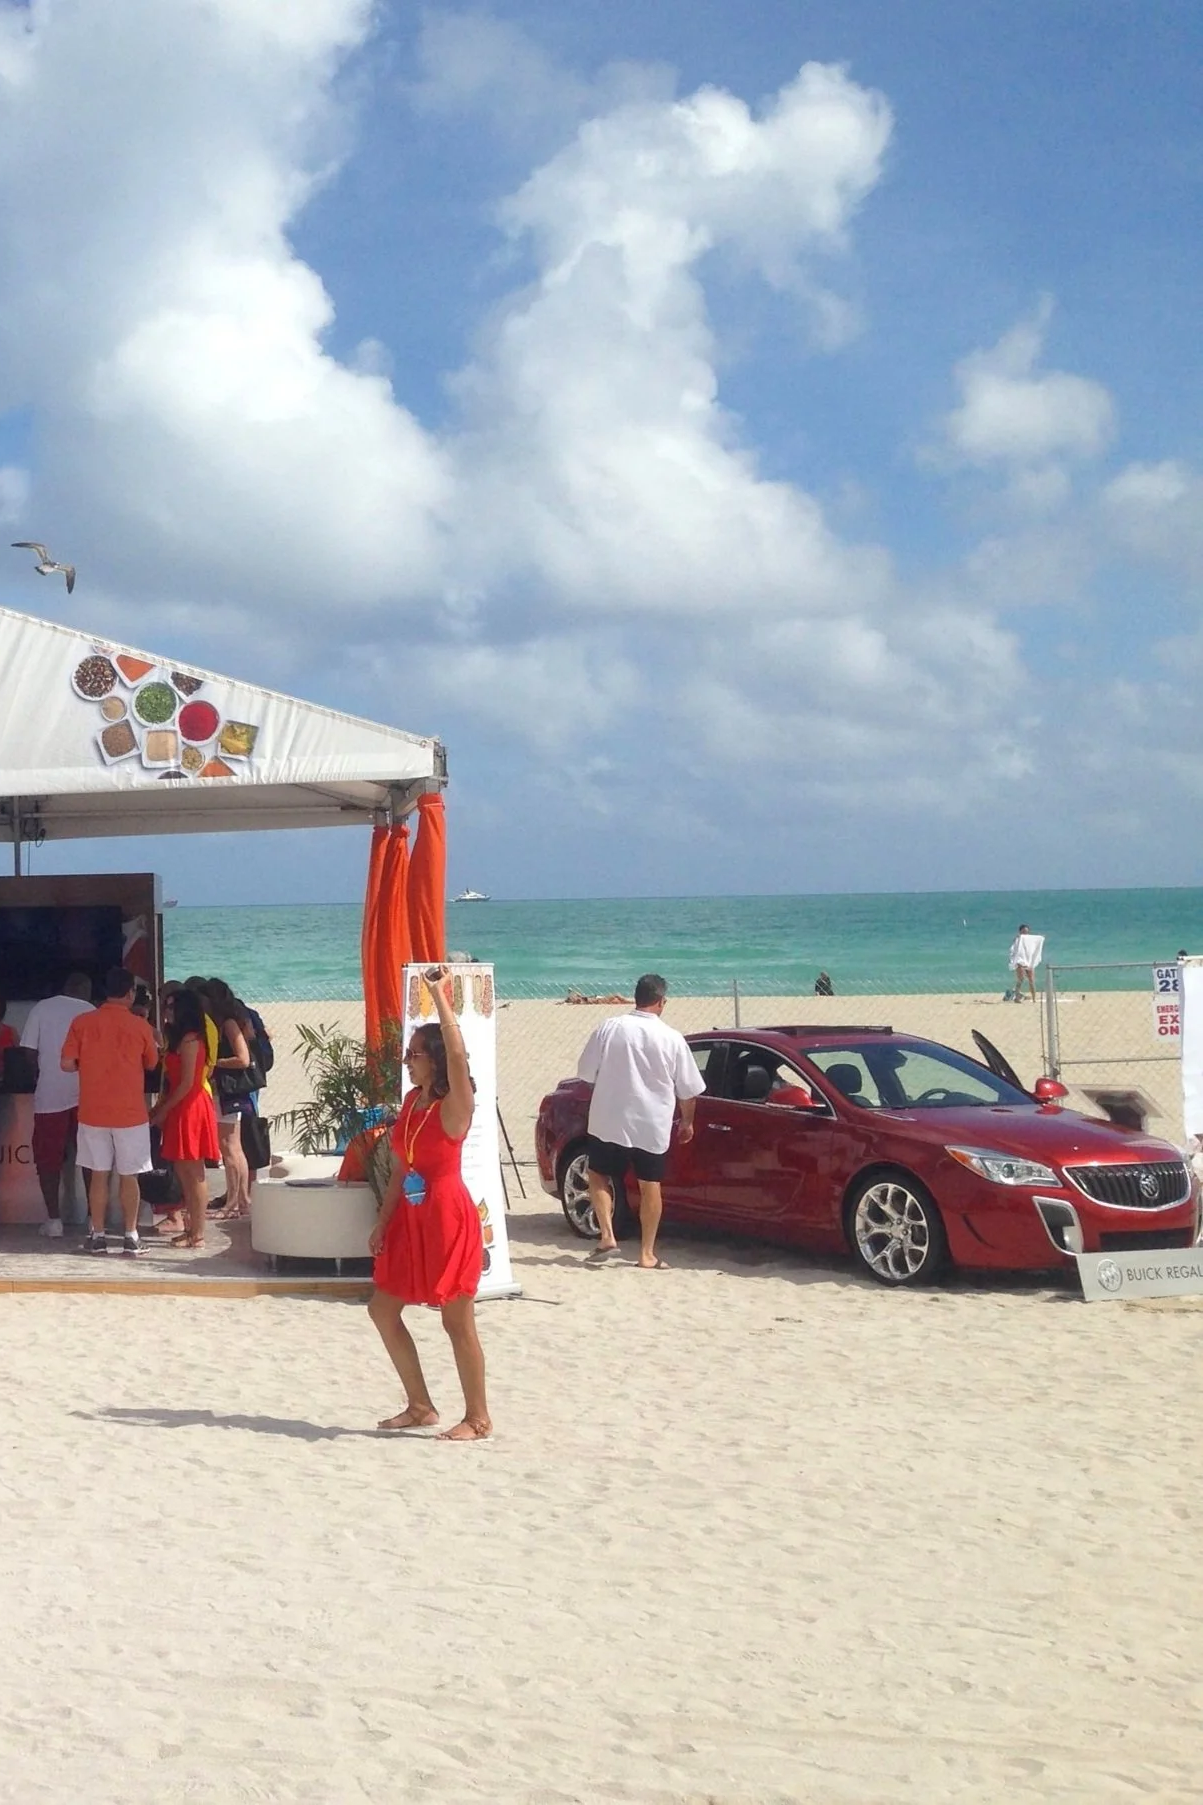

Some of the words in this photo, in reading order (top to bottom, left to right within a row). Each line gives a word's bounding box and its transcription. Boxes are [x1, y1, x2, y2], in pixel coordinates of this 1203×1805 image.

[1157, 968, 1177, 979] GAT
[1159, 1014, 1180, 1025] EX
[1158, 1025, 1180, 1036] ON
[1126, 1266, 1164, 1281] BUICK
[1165, 1264, 1203, 1280] REGAL
